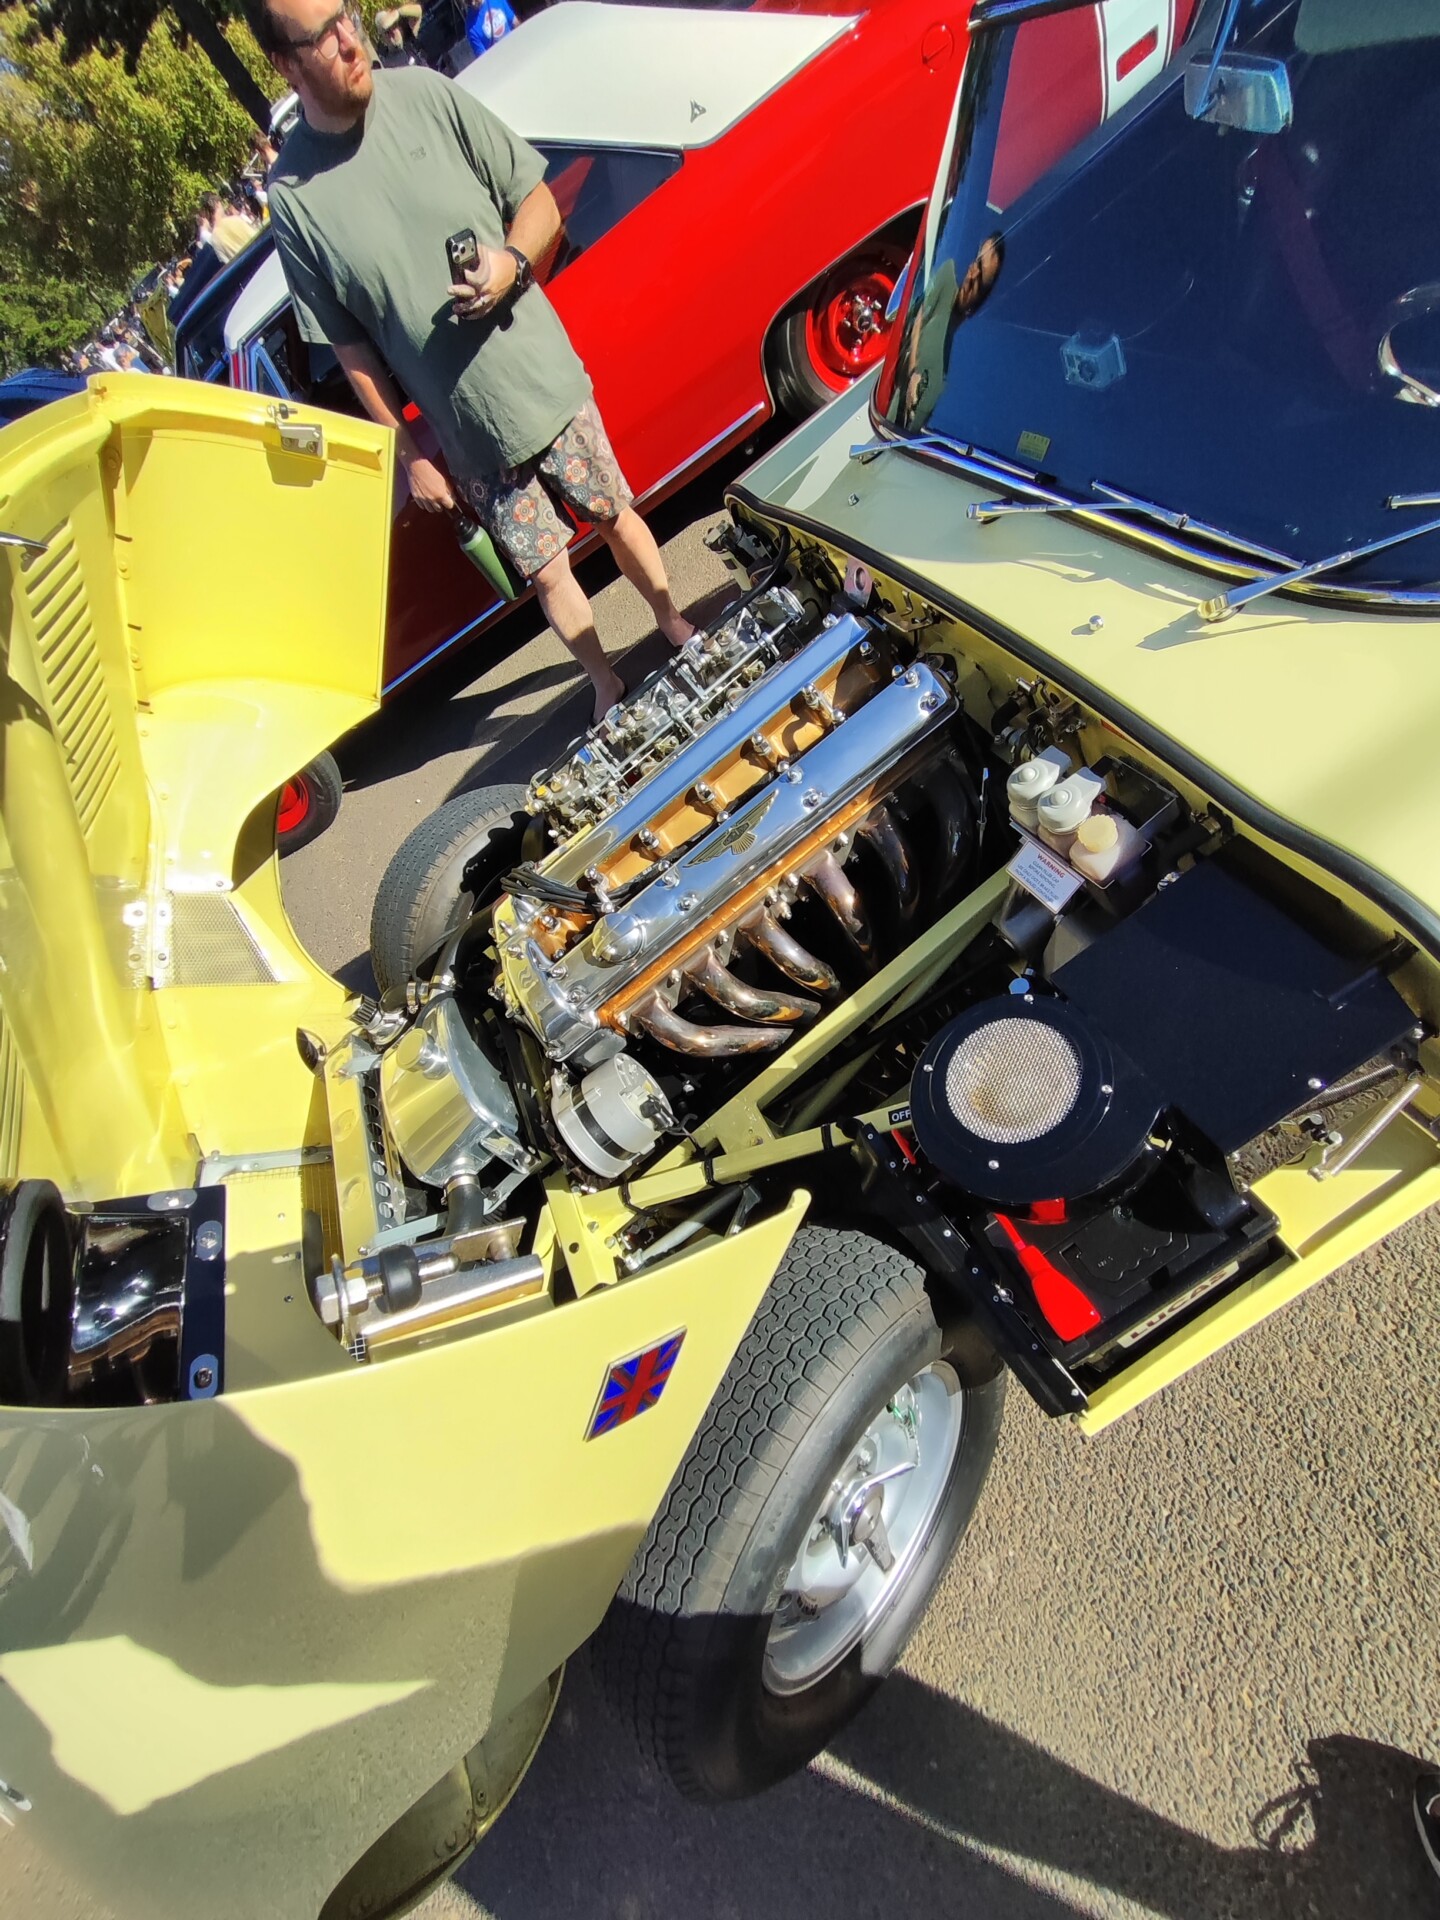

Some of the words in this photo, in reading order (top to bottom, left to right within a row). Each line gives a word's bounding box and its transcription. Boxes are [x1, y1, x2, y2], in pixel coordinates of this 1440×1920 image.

[1036, 853, 1065, 878] WARNING
[1051, 876, 1059, 884] CAP
[891, 1109, 912, 1122] OFF
[1130, 1269, 1228, 1339] LUCAS
